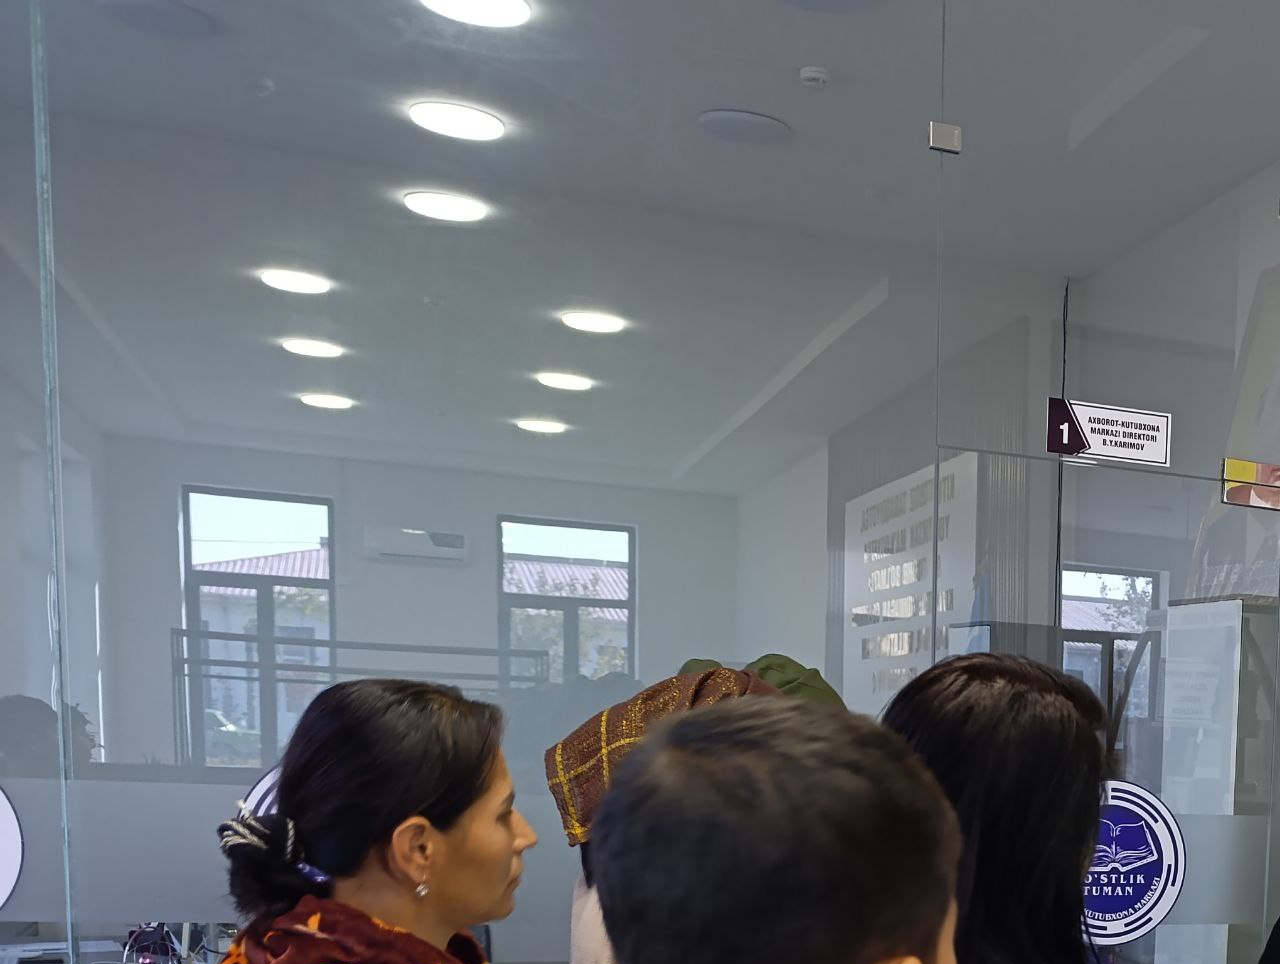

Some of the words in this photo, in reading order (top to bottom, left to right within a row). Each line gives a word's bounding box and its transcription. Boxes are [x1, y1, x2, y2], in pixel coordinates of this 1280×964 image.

[1060, 422, 1069, 444] 1
[1088, 416, 1160, 433] AXBOROT-KUTUBXONA
[1090, 426, 1120, 438] MARKAZI
[1122, 430, 1157, 443] DIREKTORI
[1085, 874, 1145, 884] O'STLIK
[1084, 886, 1133, 896] TUMAN
[1134, 877, 1160, 910] MARKAZI
